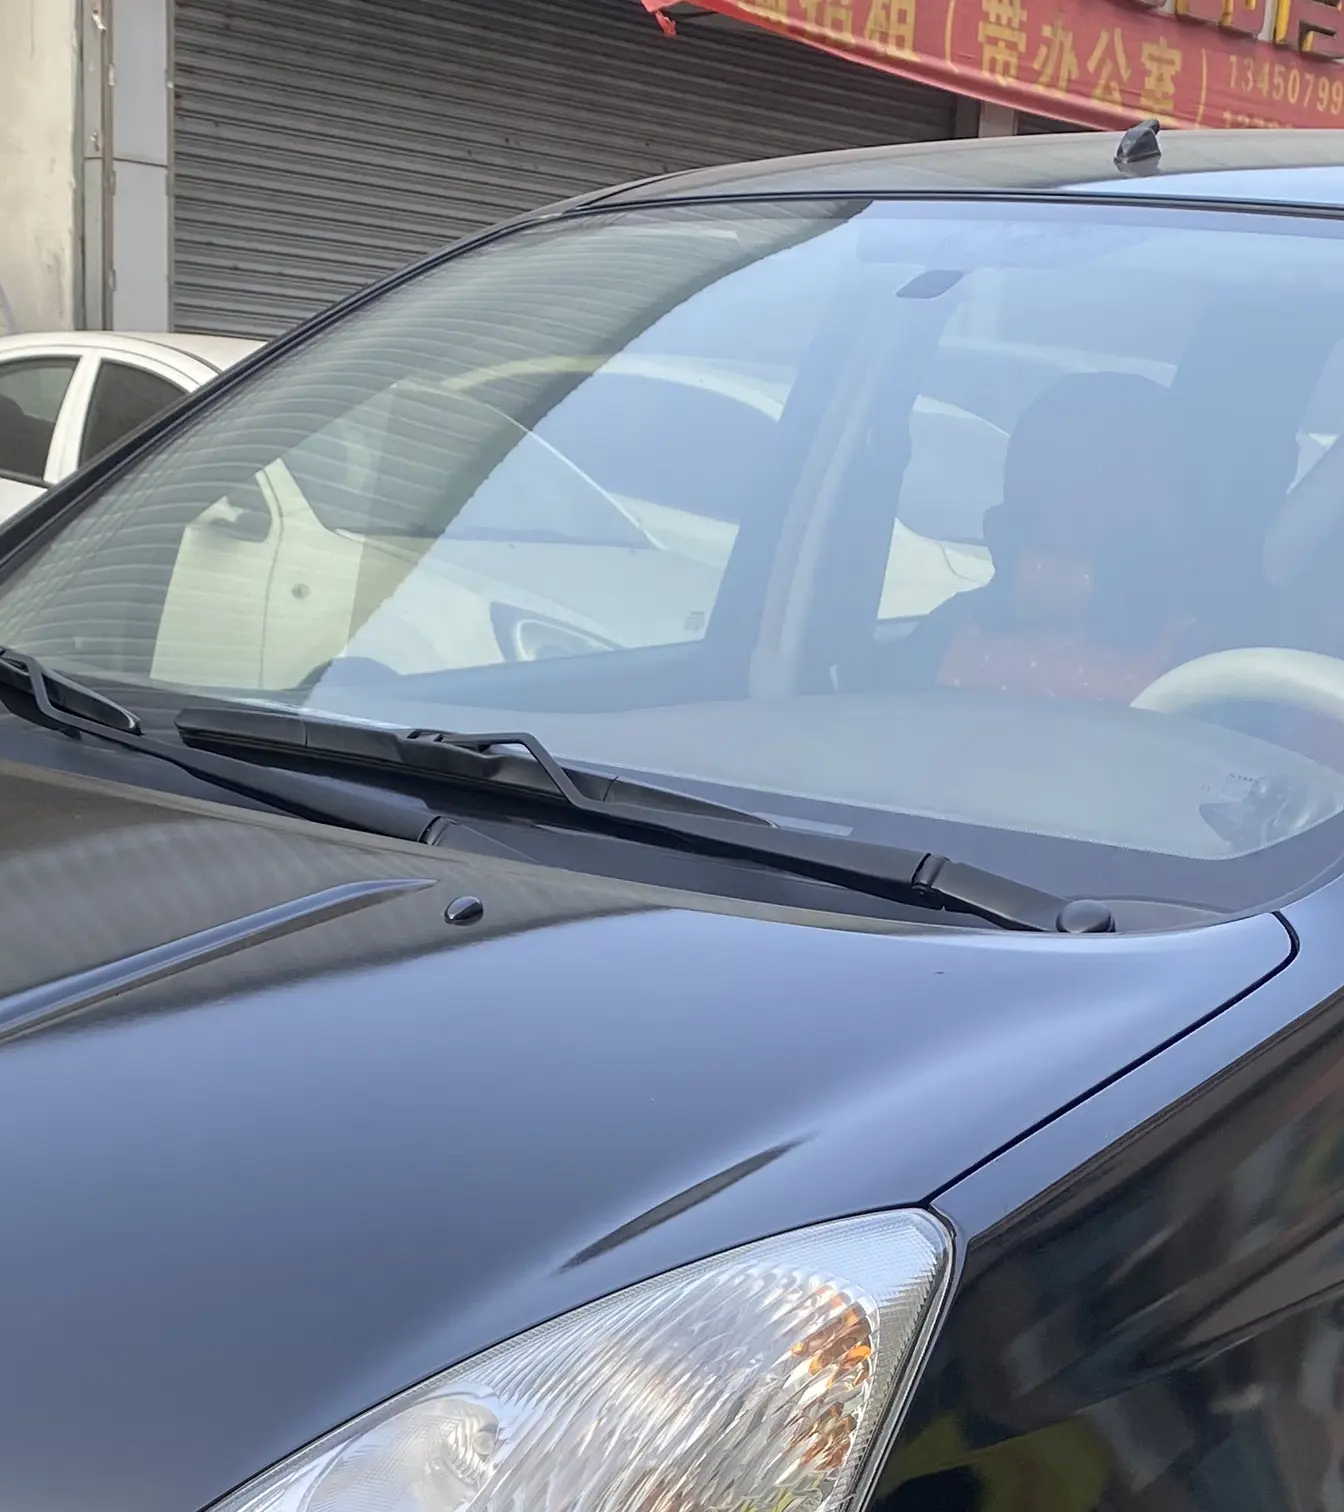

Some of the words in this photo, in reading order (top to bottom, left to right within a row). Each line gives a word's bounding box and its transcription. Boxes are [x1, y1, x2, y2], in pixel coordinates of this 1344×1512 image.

[741, 0, 1208, 128] 招租（带办公室）
